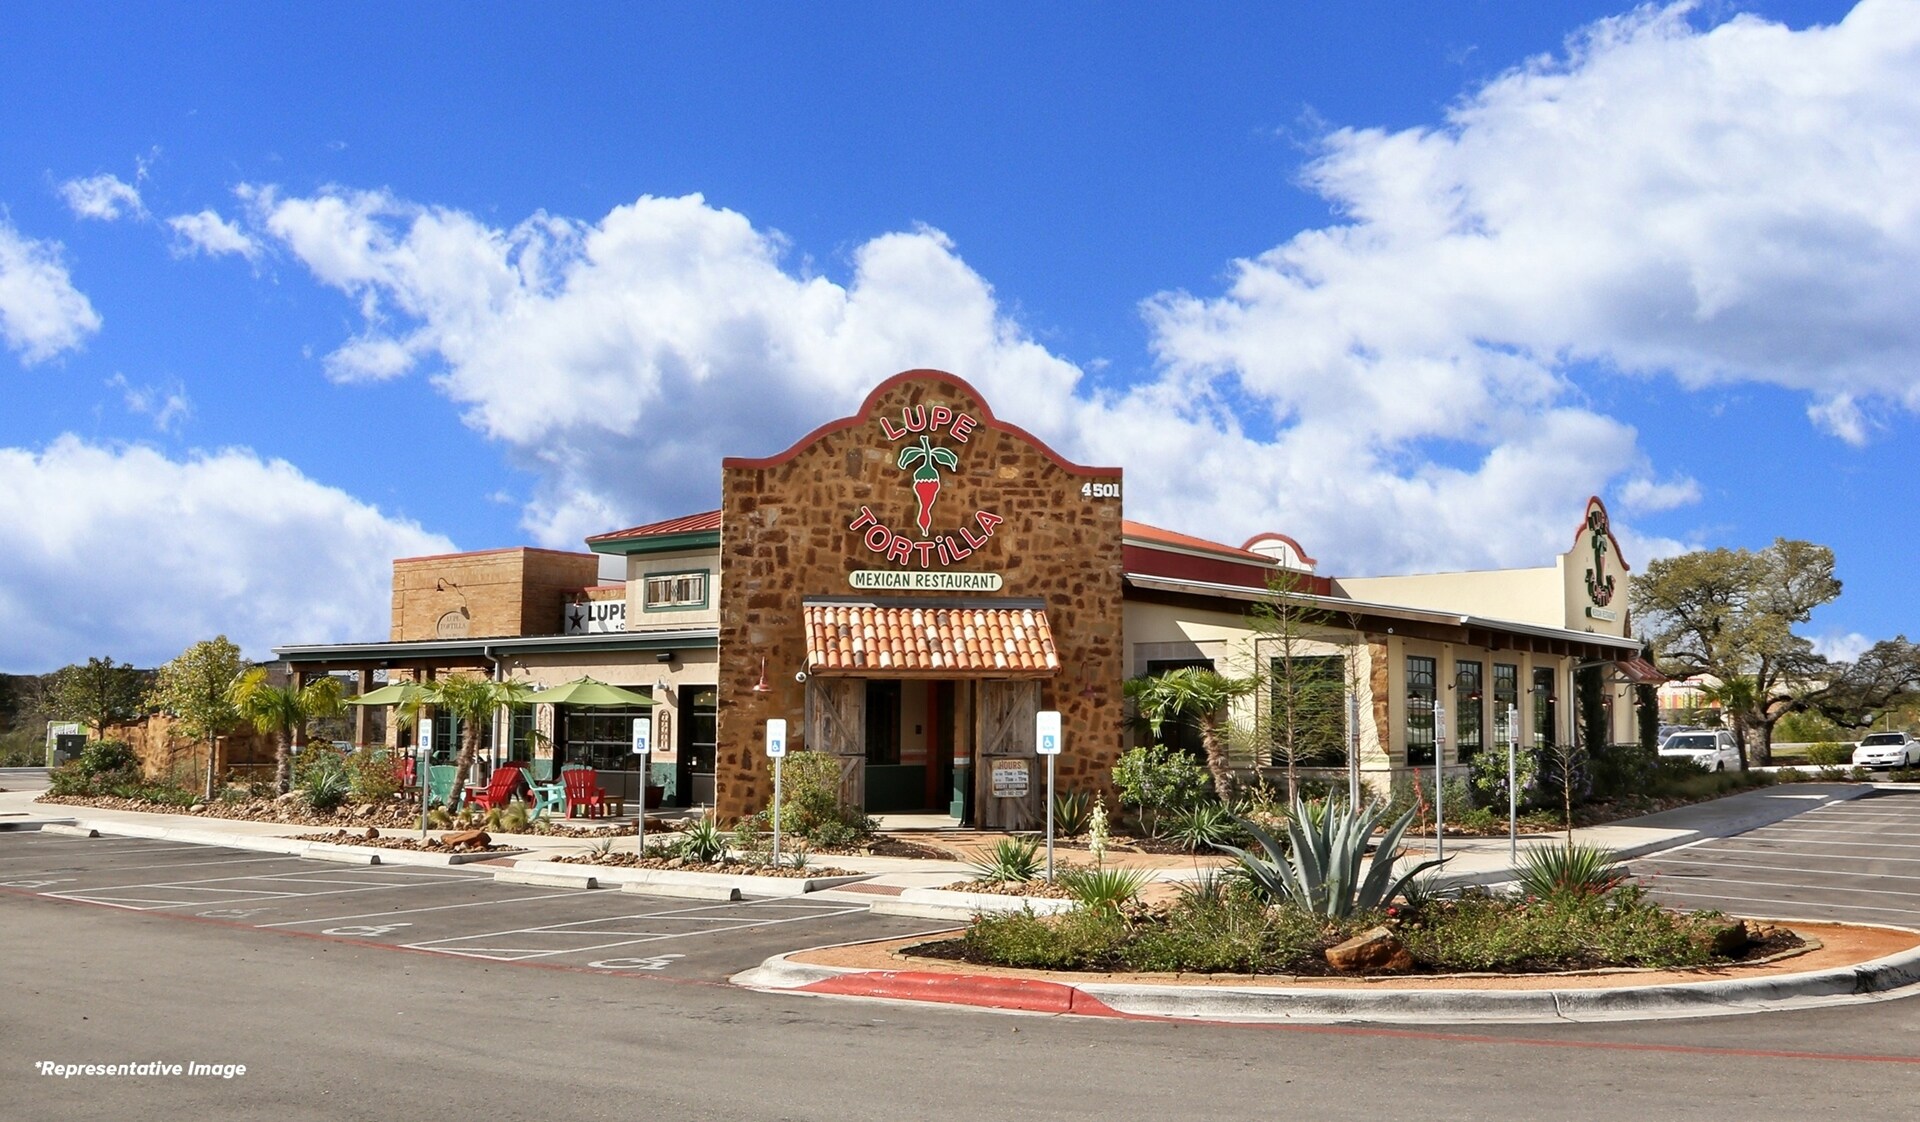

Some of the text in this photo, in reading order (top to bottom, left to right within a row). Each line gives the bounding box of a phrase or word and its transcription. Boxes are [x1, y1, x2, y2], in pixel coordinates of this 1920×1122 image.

[880, 404, 977, 443] LUPE
[1081, 482, 1120, 498] 4501
[855, 572, 996, 589] MEXICAN RESTAURANT
[998, 760, 1022, 769] HOURS
